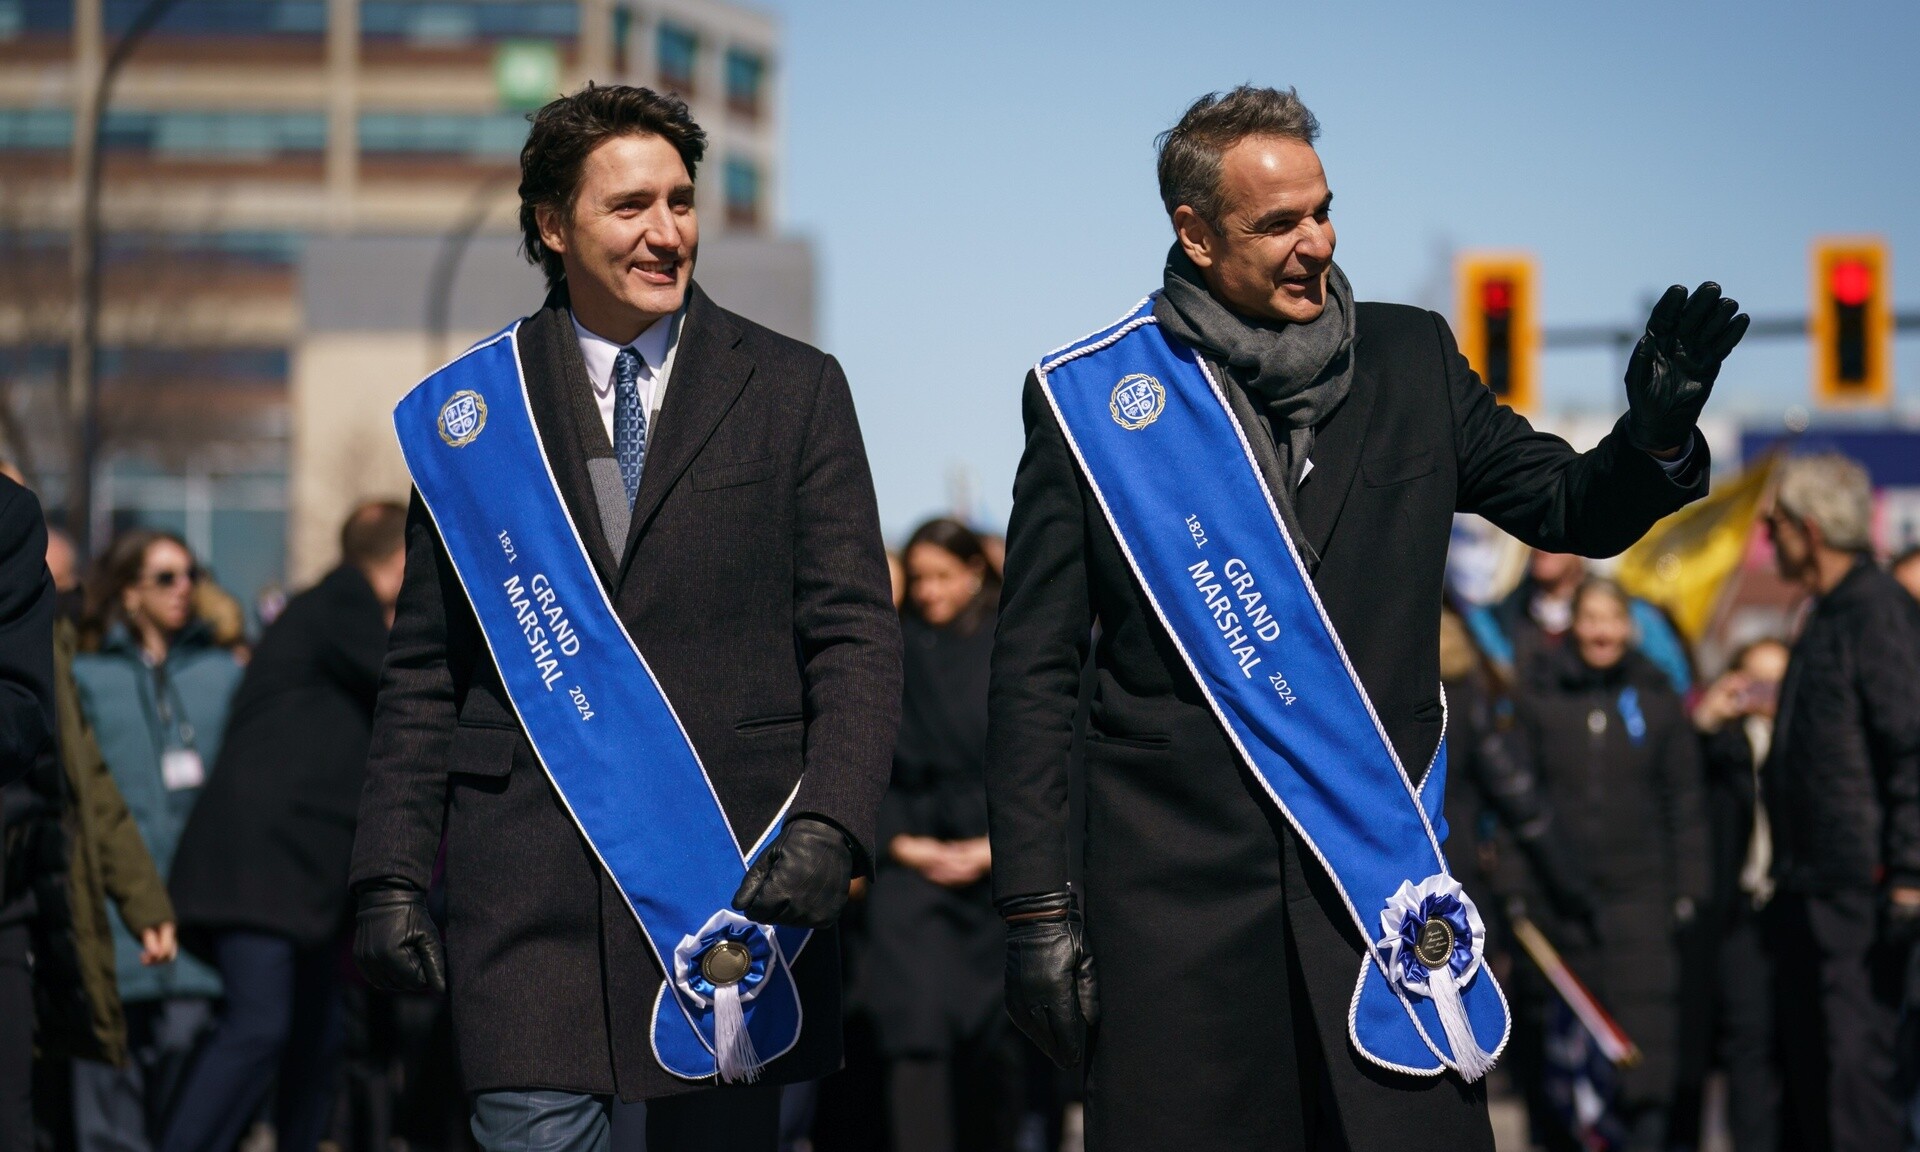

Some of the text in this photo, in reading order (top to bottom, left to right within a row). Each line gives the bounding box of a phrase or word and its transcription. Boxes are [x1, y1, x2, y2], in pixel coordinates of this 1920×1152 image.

[497, 529, 518, 564] 1821
[1185, 514, 1208, 549] 1821
[531, 573, 580, 657] GRAND
[1188, 560, 1262, 679] MARSHAL
[1224, 558, 1281, 643] GRAND
[503, 575, 564, 692] MARSHAL
[569, 685, 595, 721] 2024
[1269, 671, 1297, 706] 2024
